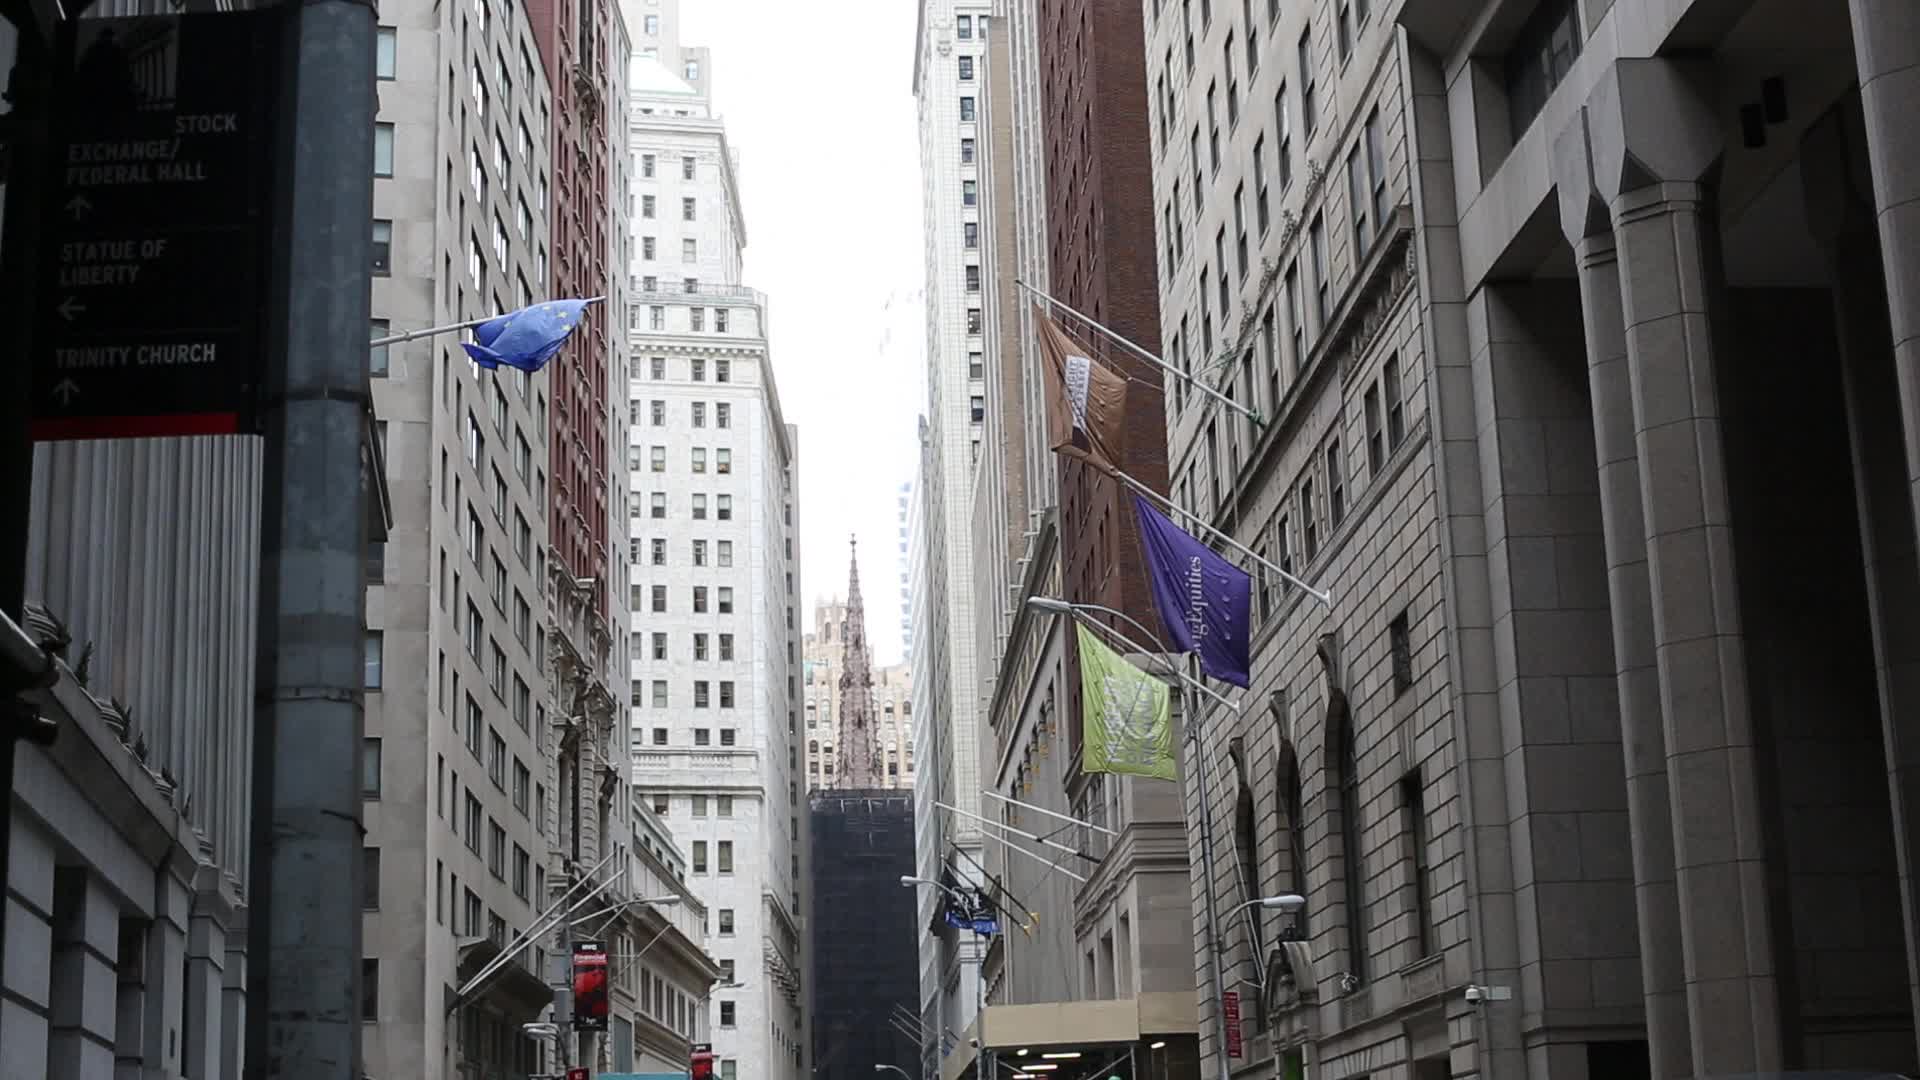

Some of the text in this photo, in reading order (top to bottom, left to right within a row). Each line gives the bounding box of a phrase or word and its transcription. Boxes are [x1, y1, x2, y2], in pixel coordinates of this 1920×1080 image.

[176, 113, 237, 133] STOCK
[68, 139, 181, 162] EXCHANGE/
[66, 161, 207, 185] FEDERAL HALL
[62, 240, 167, 261] STATUE OF
[60, 265, 139, 287] LIBERTY
[56, 344, 216, 367] TRINITY CHURCH
